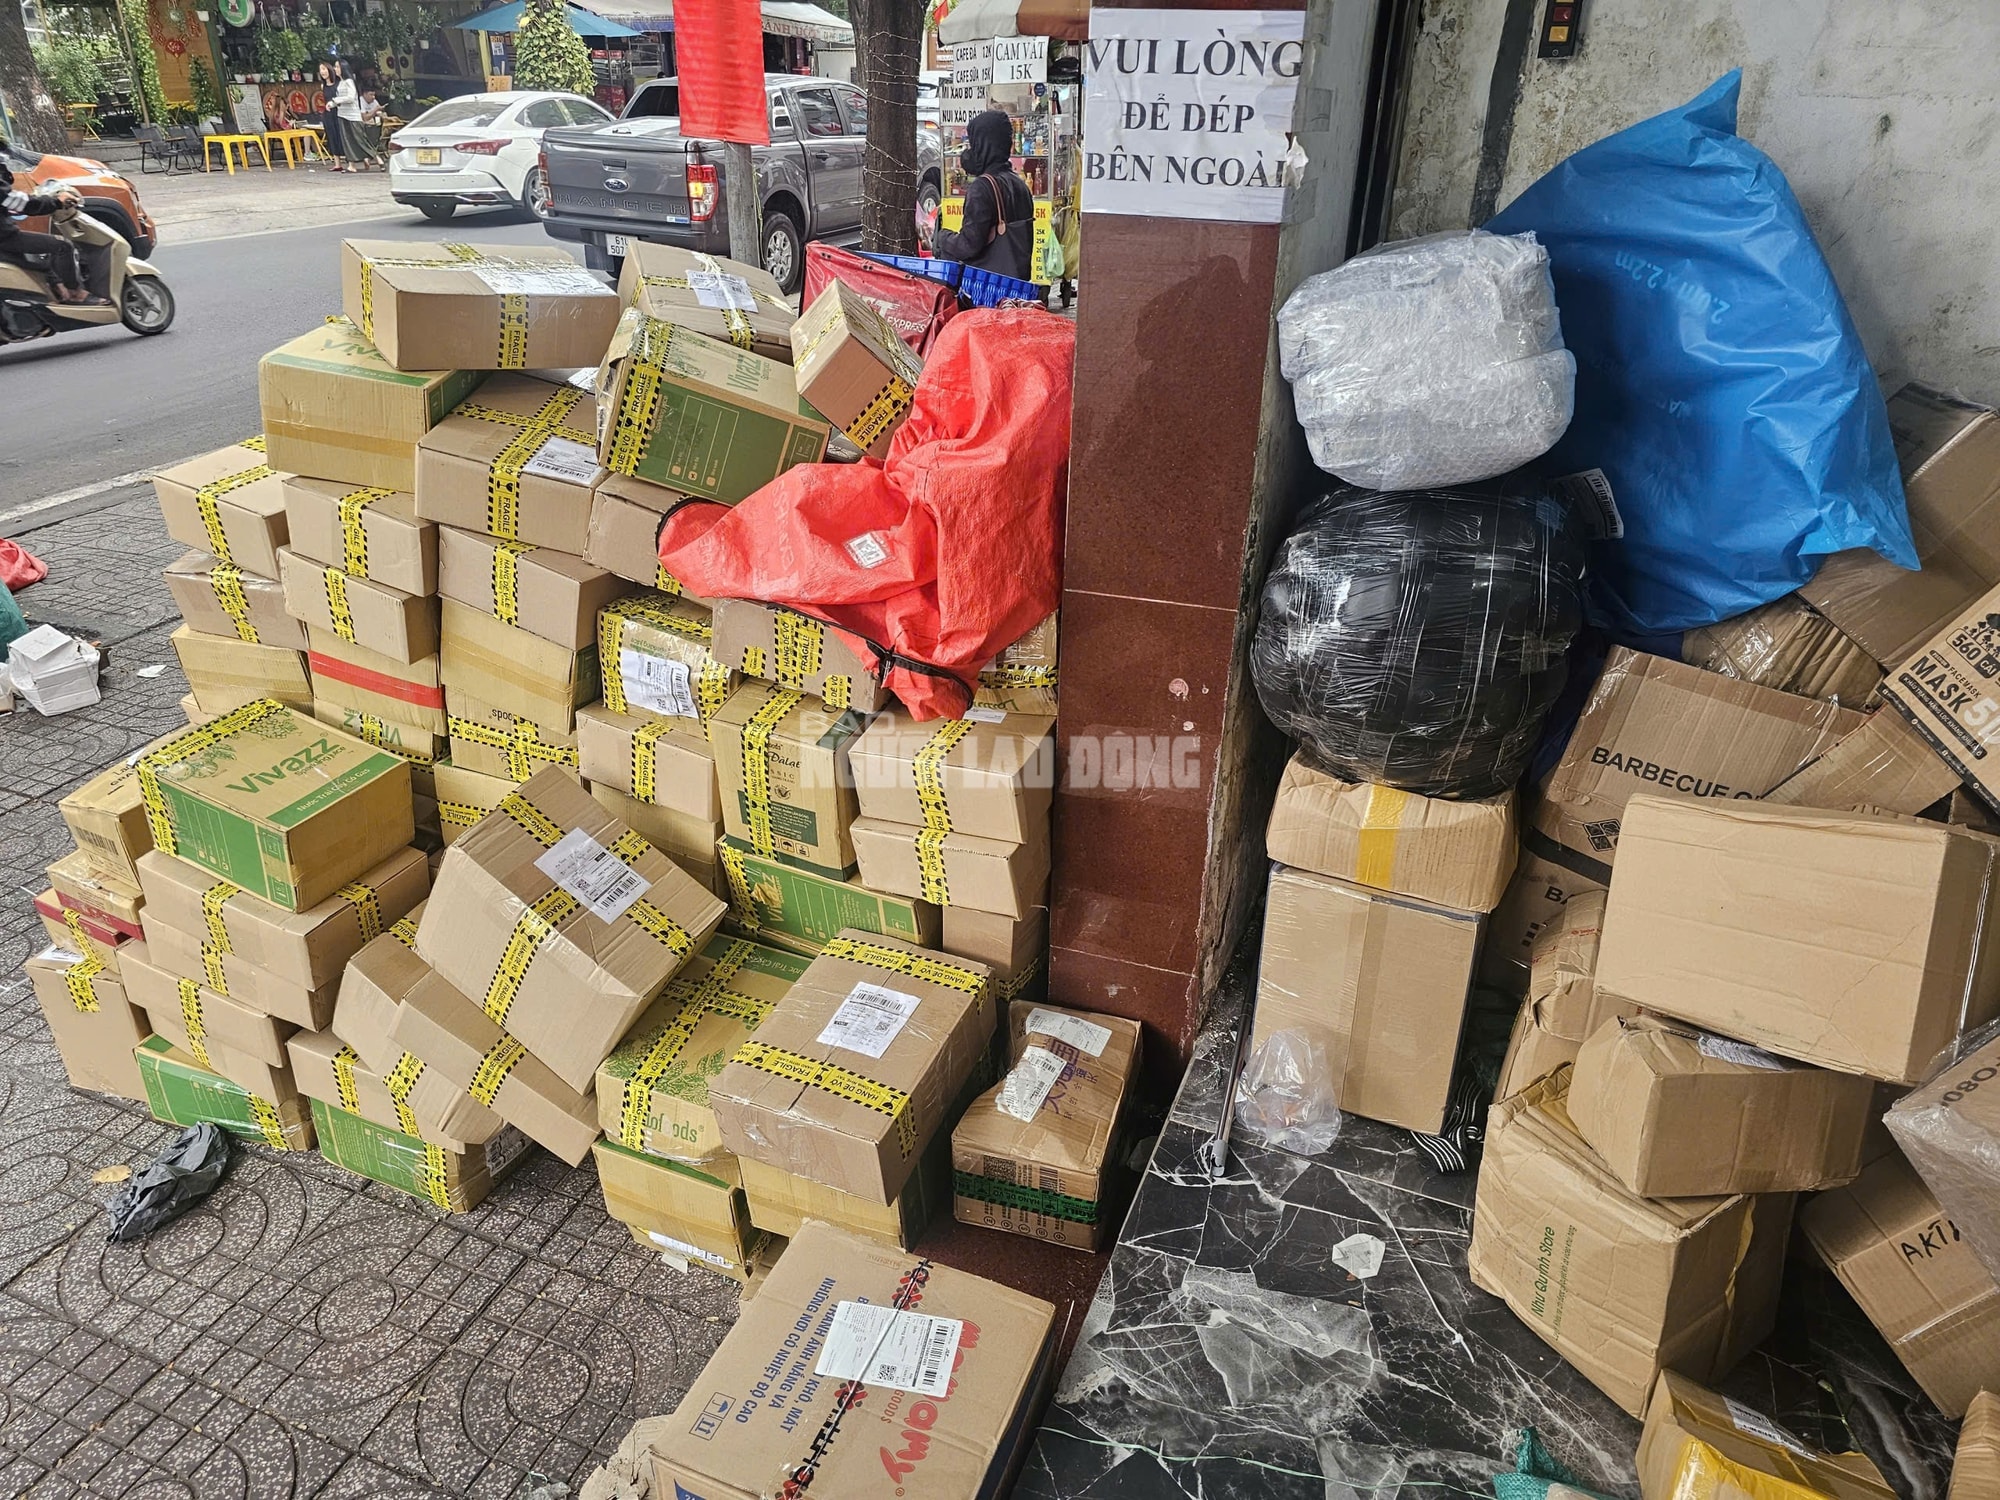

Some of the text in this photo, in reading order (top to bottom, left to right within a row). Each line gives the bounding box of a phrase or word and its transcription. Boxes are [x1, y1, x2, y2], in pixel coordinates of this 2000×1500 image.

[996, 42, 1020, 60] CAM
[1088, 29, 1303, 78] VUI LÒNG
[1010, 64, 1032, 80] 15K
[1122, 93, 1254, 133] ĐỂ DÉP
[1086, 145, 1154, 182] BÊN
[556, 194, 686, 214] RANGER
[511, 330, 520, 366] FRAGILE
[632, 372, 647, 412] FRAGILE
[858, 410, 888, 442] FRAGILE
[1952, 634, 1997, 676] 560 CÁI
[994, 671, 1034, 682] FRAGILE
[1909, 656, 1973, 714] MASK
[1948, 666, 1982, 699] FACEMASK
[226, 738, 339, 793] Vivazz
[1591, 747, 1730, 799] BARBECUE
[862, 952, 899, 965] FRAGILE
[772, 1060, 810, 1077] FRAGILE
[1539, 1226, 1555, 1256] Store
[736, 1278, 836, 1424] NHỮNG NƠI CÓ NHIỆT ĐỘ CAO
[800, 1337, 822, 1360] ÁNH
[779, 1361, 806, 1393] NẮNG
[768, 1393, 788, 1409] VÀ
[881, 1390, 905, 1424] GOODS
[780, 1409, 804, 1434] MÁT
